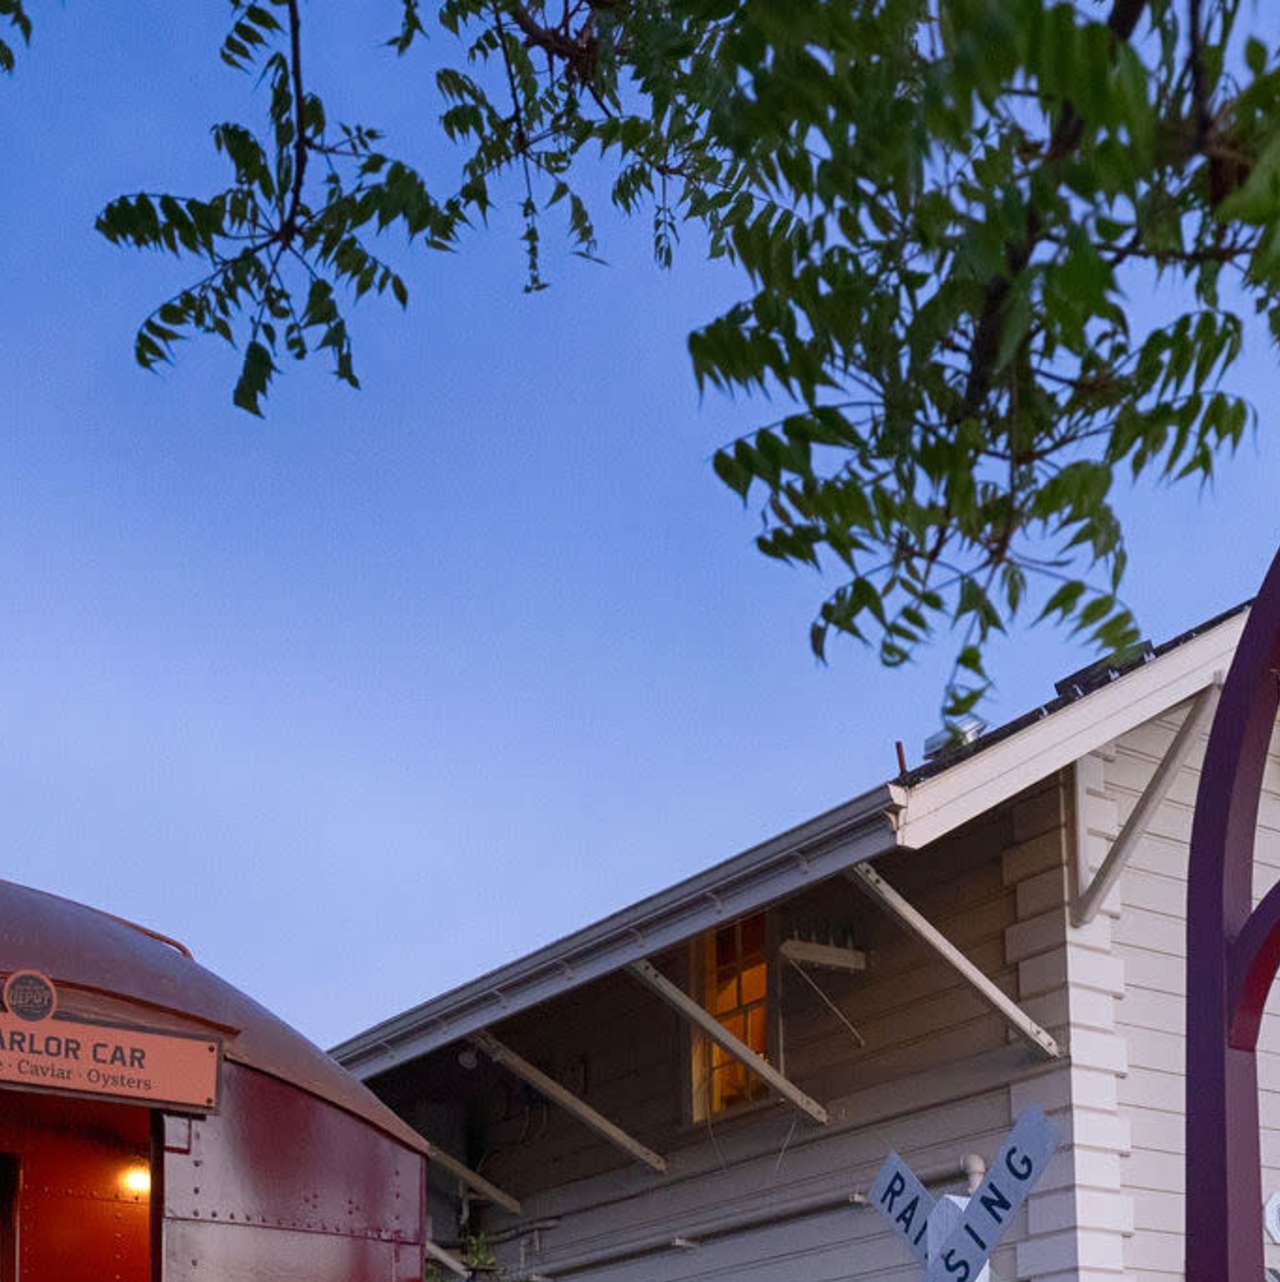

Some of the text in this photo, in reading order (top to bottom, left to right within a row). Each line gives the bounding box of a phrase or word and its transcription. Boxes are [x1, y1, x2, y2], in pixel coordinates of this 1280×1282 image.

[91, 1042, 147, 1069] CAR
[16, 1059, 73, 1081] Caviar
[86, 1068, 153, 1091] Oysters
[880, 1171, 928, 1259] RAI
